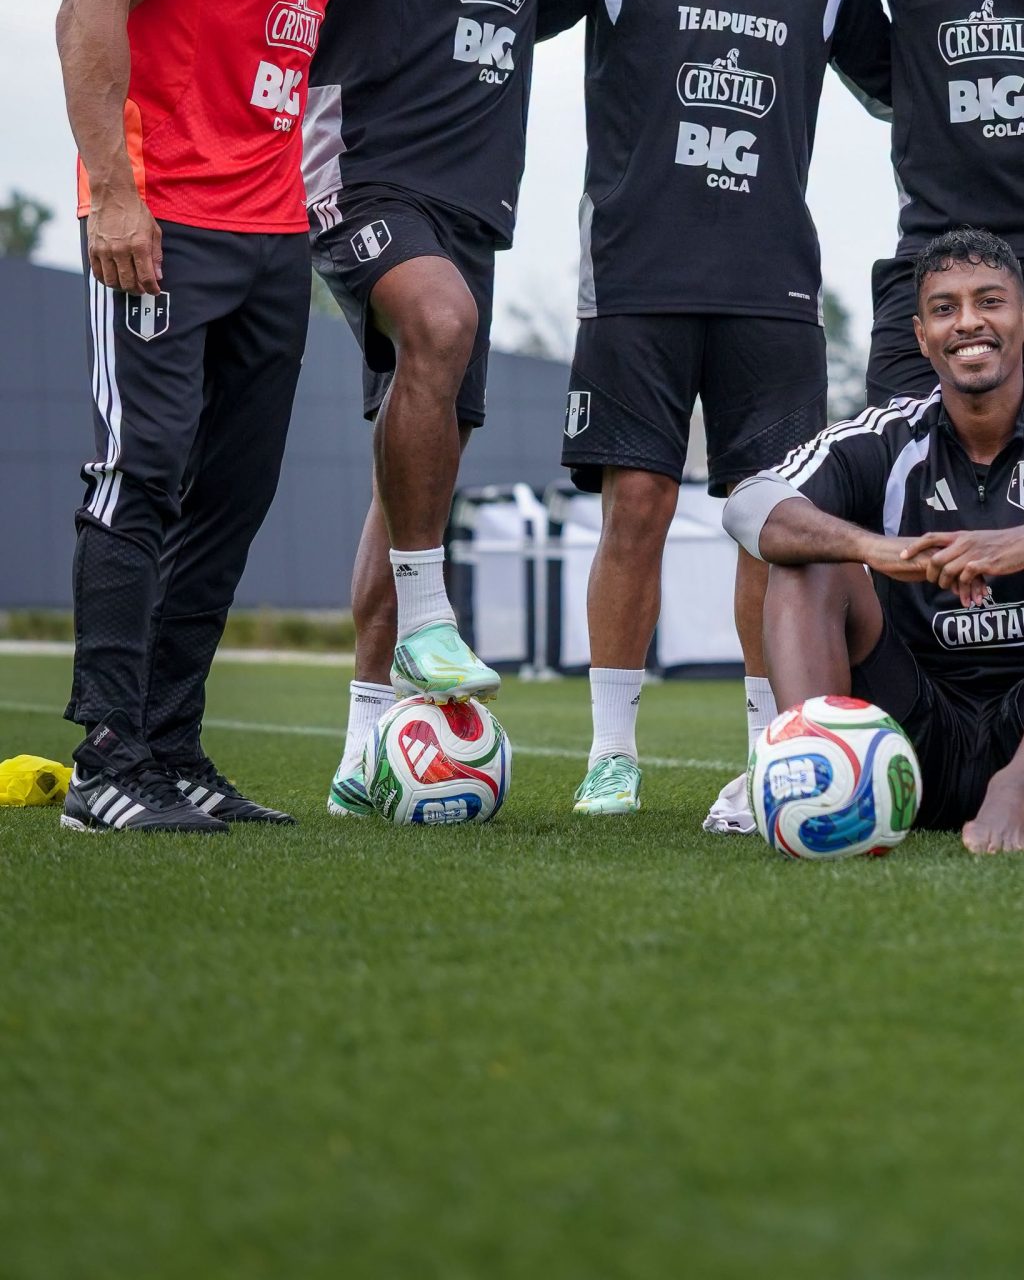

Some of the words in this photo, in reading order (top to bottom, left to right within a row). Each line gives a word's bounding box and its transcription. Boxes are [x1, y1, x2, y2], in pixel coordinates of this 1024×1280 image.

[272, 9, 320, 50] CRISTAL
[453, 16, 517, 71] BIG
[678, 5, 701, 31] TE
[700, 9, 788, 47] APUESTO
[684, 69, 766, 111] CRISTAL
[674, 120, 760, 177] BIG
[706, 173, 751, 193] COLA
[132, 306, 164, 317] FPF
